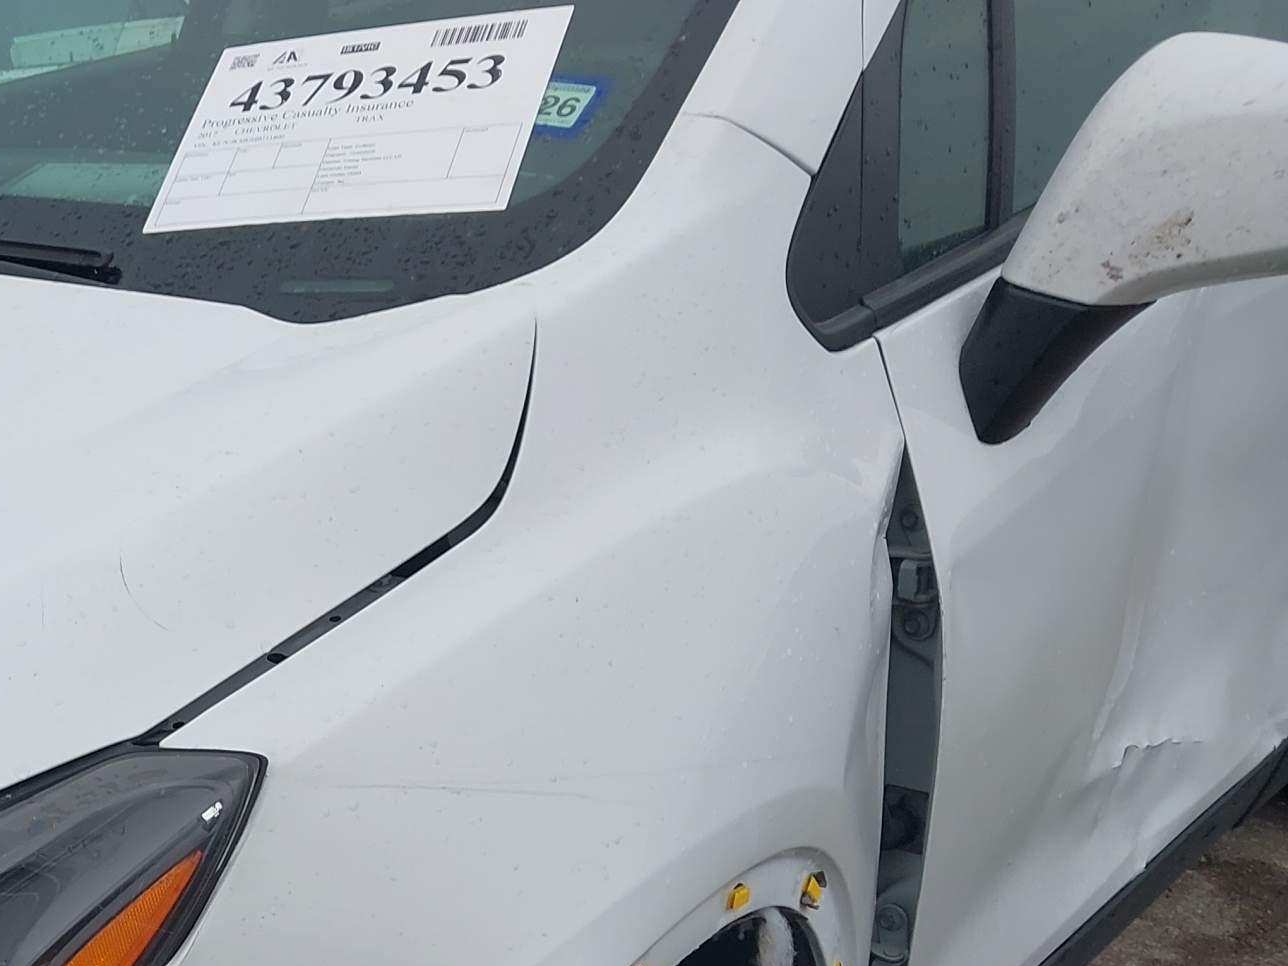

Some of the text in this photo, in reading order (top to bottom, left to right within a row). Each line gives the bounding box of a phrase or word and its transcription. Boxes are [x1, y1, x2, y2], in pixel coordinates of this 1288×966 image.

[230, 54, 506, 113] 43793453
[202, 98, 415, 129] Progressive Casualty Insurance
[538, 95, 580, 117] 26
[234, 123, 296, 136] CHEVROLET
[356, 114, 384, 123] TRAX
